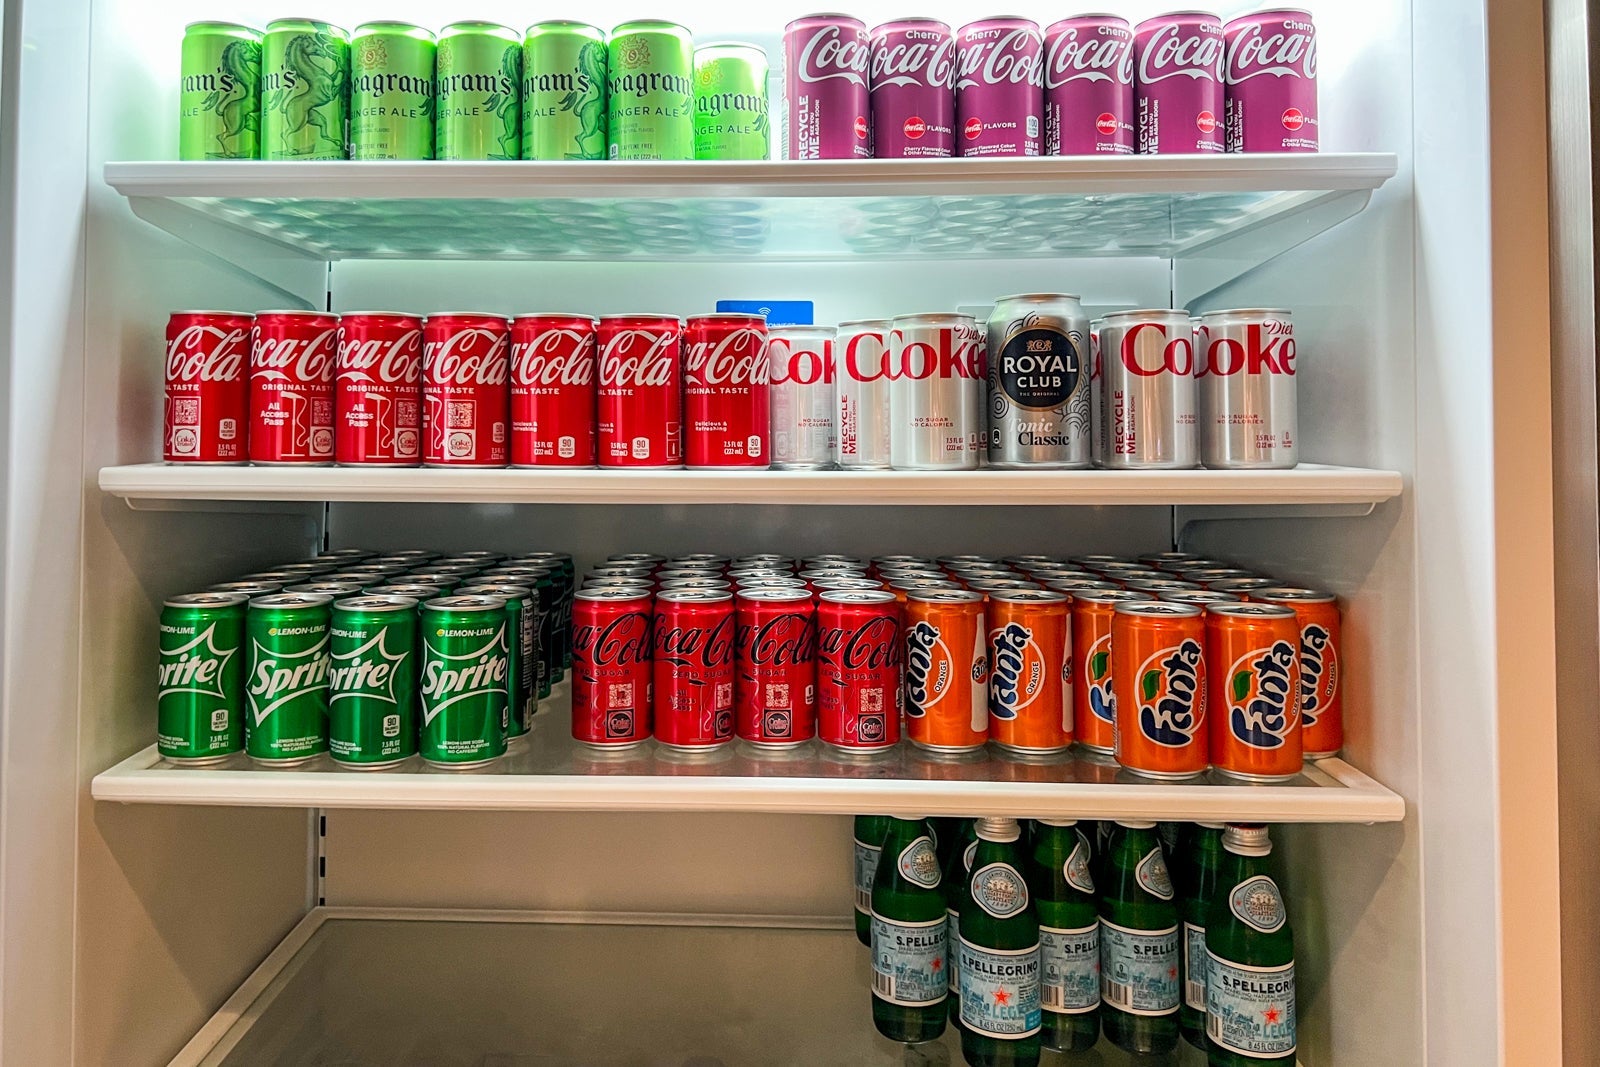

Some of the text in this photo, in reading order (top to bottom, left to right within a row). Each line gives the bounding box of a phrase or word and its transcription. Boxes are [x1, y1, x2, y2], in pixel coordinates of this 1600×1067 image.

[1098, 26, 1129, 39] Cherry
[1283, 20, 1314, 34] Cherry
[905, 31, 942, 42] Cherry
[965, 30, 1001, 43] Cherry
[390, 107, 417, 118] ALE
[455, 107, 480, 116] ALE
[534, 107, 556, 117] ALE
[610, 106, 679, 120] GINGER ALE
[727, 125, 751, 134] ALE
[798, 95, 809, 160] RECYCLE
[809, 136, 820, 159] ME
[1262, 318, 1293, 335] Diet
[1003, 355, 1078, 374] ROYAL
[1017, 376, 1062, 388] CLUB
[347, 385, 391, 393] ORIGINAL
[268, 403, 281, 411] All
[353, 404, 365, 412] All
[223, 422, 233, 430] 90
[264, 418, 285, 426] Pass
[349, 420, 369, 428] Pass
[1008, 417, 1053, 433] Tonic
[1114, 390, 1123, 455] RECYCLE
[562, 440, 572, 448] 90
[636, 440, 646, 449] 90
[750, 438, 759, 447] 90
[849, 433, 857, 455] ME
[1018, 431, 1070, 446] Classic
[1126, 433, 1136, 455] ME
[278, 624, 326, 636] LEMON-LIME
[445, 628, 494, 637] LEMON-LIME
[422, 654, 507, 700] Sprite
[672, 670, 699, 679] ZERO
[934, 660, 947, 693] ORANGE
[990, 622, 1032, 721] Fanta
[1026, 662, 1040, 695] ORANGE
[1326, 662, 1336, 697] ORANGE
[1139, 638, 1202, 748] Fanta
[1229, 640, 1296, 750] Fanta
[216, 712, 225, 721] 90
[387, 717, 397, 726] 90
[962, 953, 1038, 976] S.PELLEGRINO
[1267, 1043, 1275, 1051] OZ
